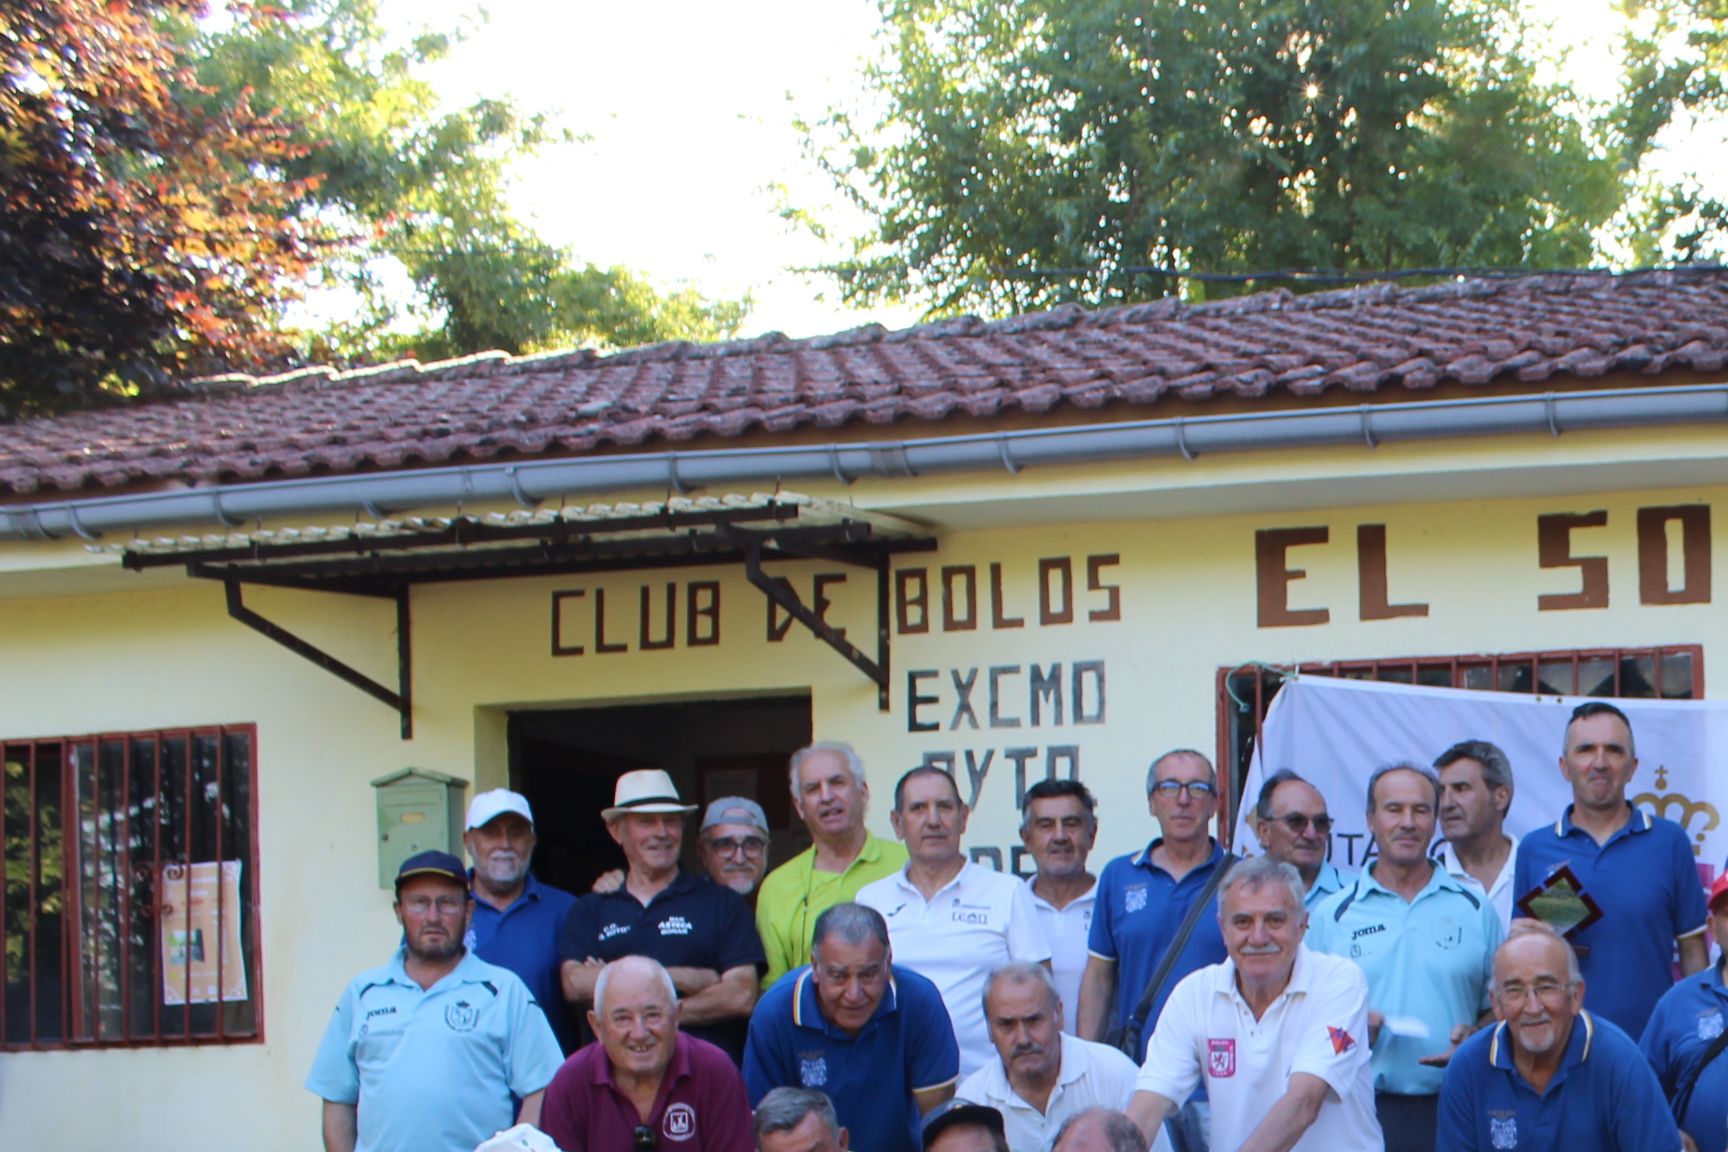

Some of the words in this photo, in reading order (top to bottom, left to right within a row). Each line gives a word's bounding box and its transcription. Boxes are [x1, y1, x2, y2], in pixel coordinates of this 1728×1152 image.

[551, 580, 720, 657] CLUB
[896, 553, 1121, 635] BOLOS
[1255, 525, 1430, 628] EL
[907, 659, 1106, 733] EXCMO
